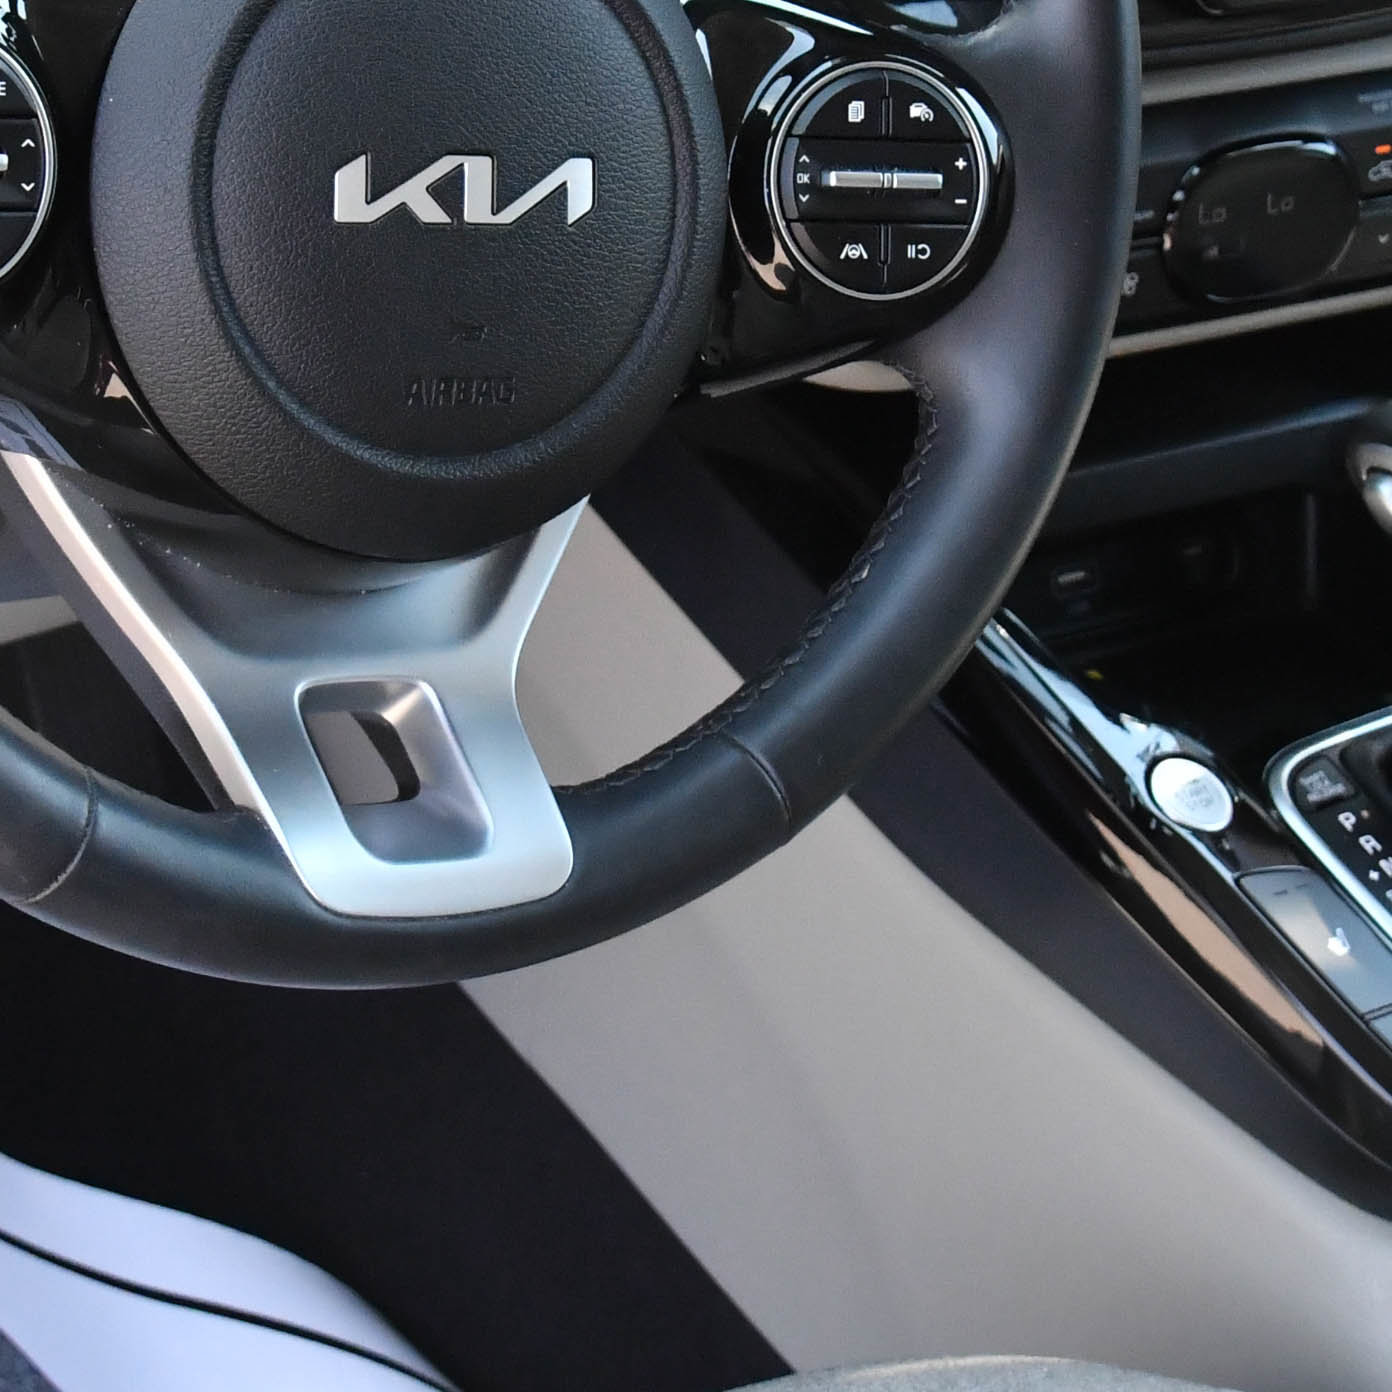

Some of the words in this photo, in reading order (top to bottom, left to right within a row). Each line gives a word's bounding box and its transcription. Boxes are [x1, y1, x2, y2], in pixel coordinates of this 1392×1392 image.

[796, 173, 810, 185] OK
[334, 154, 594, 226] KIA
[1338, 811, 1356, 832] P
[1358, 834, 1383, 856] R
